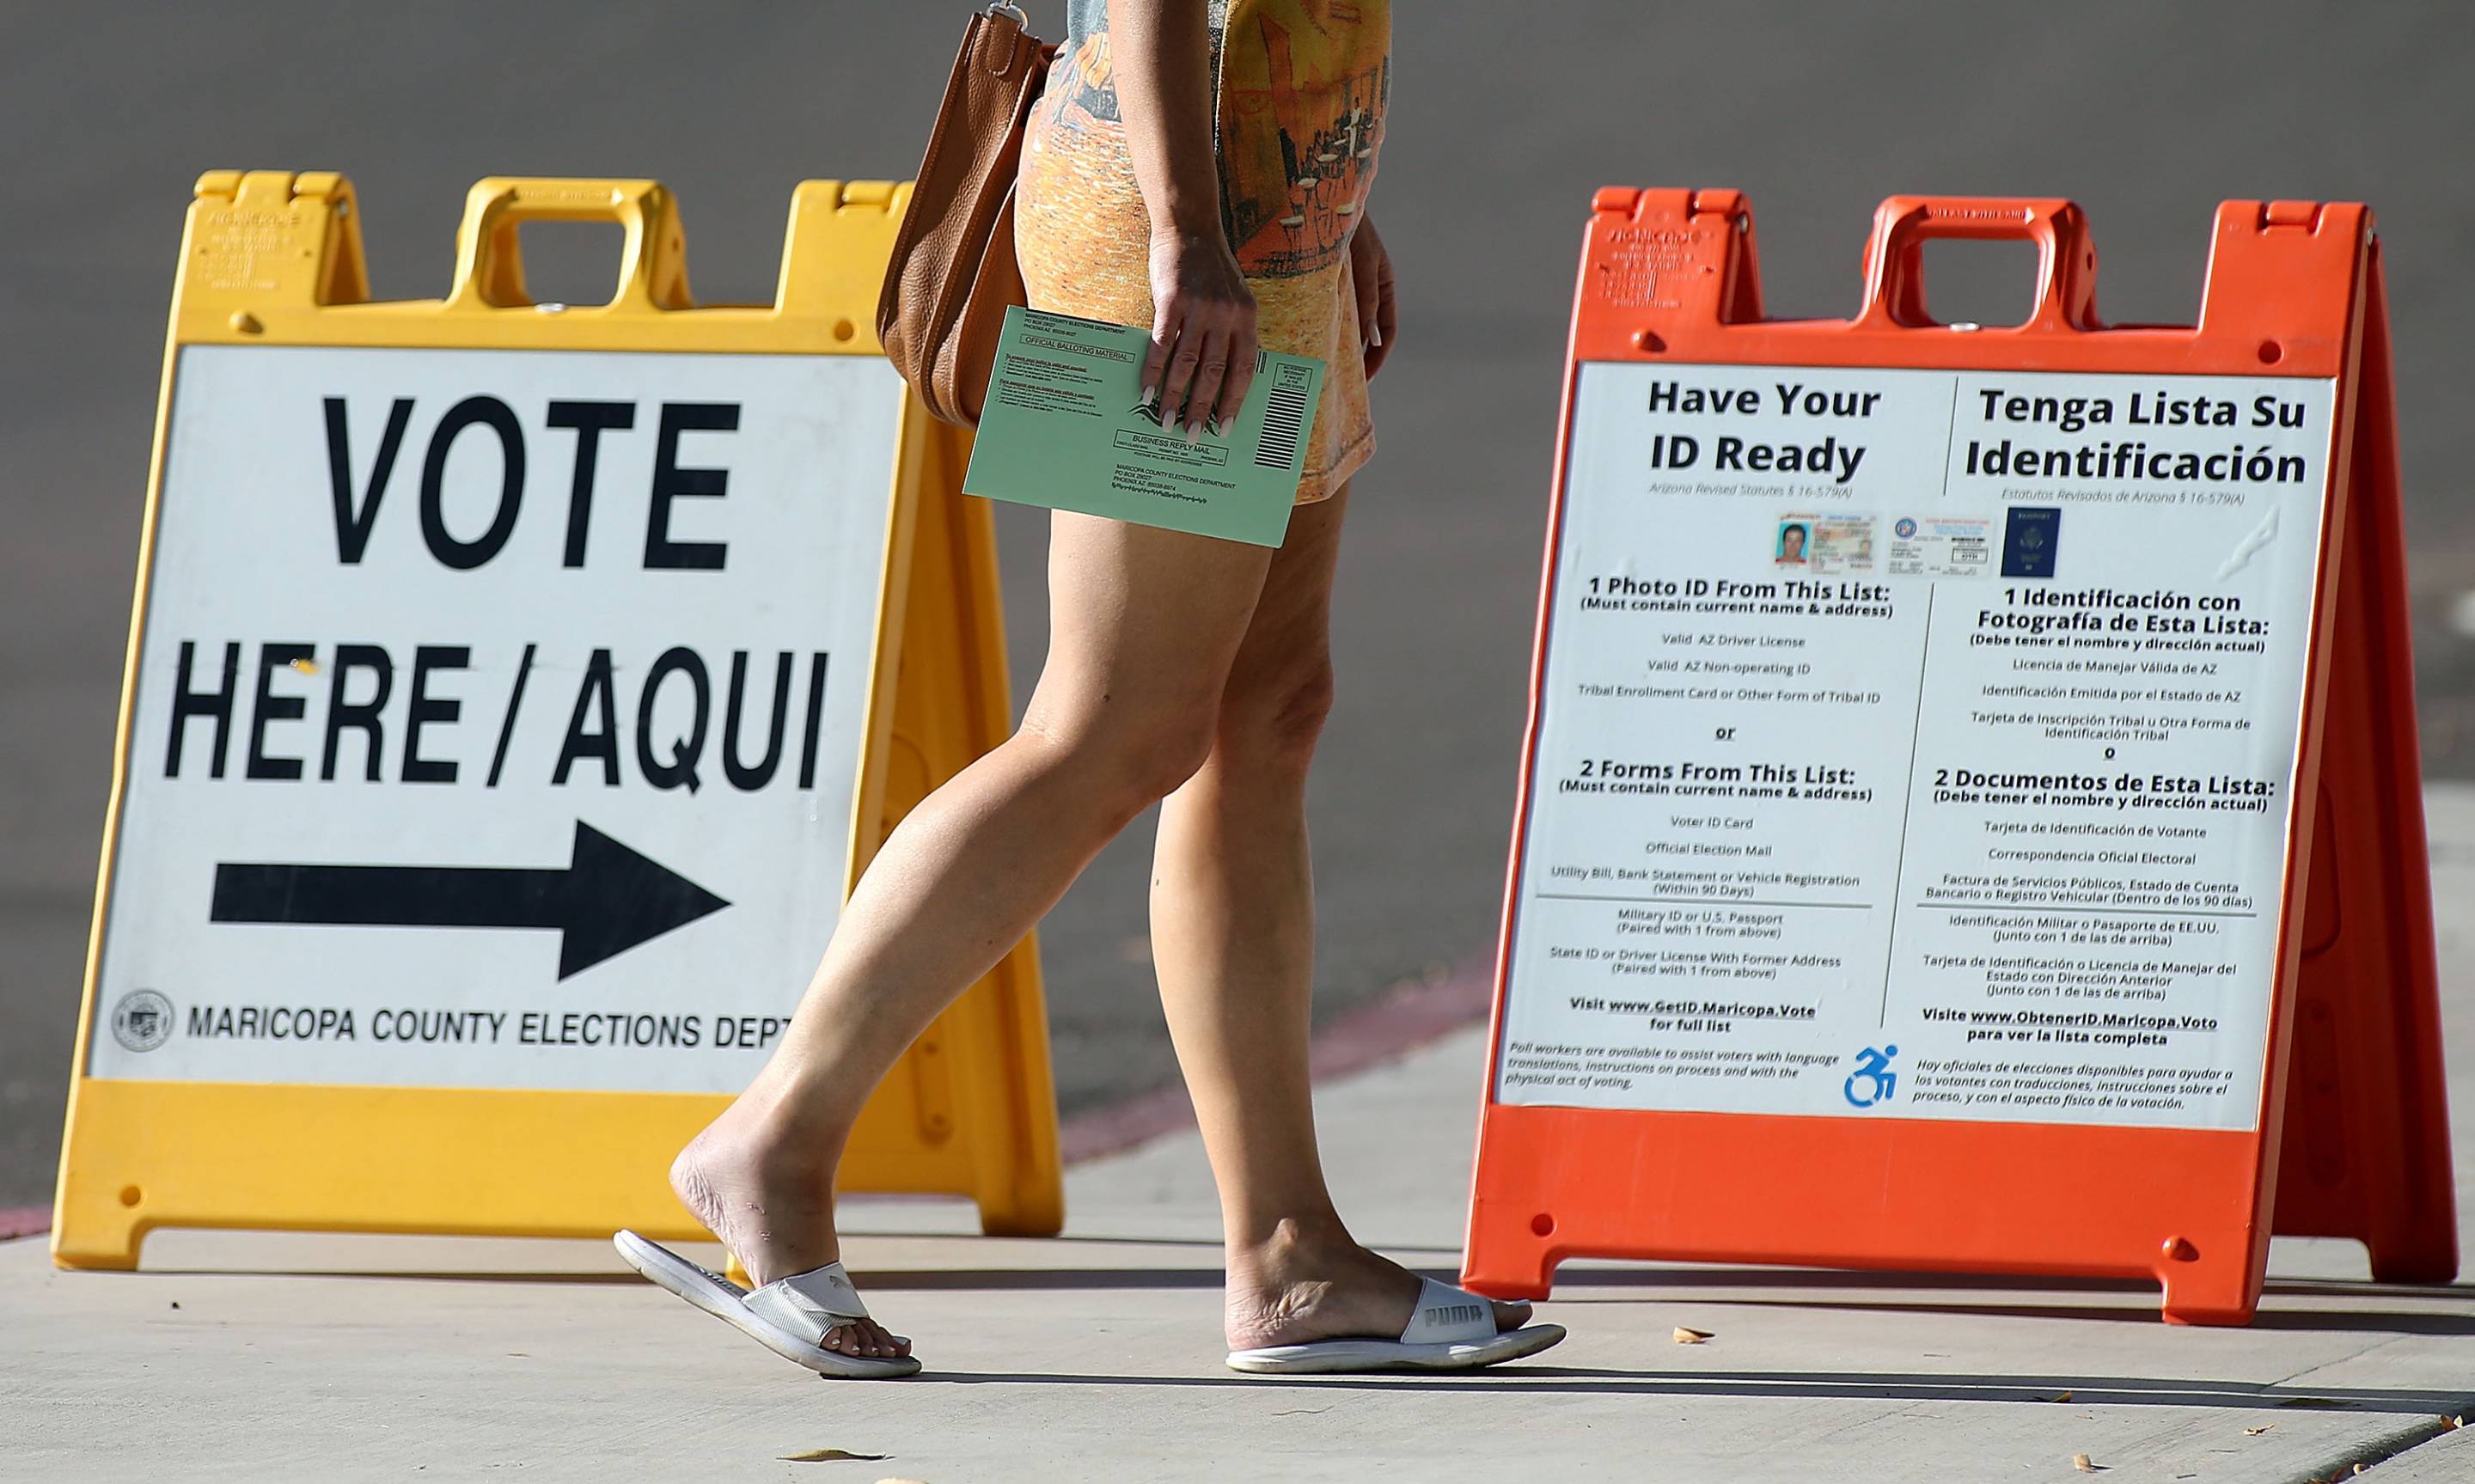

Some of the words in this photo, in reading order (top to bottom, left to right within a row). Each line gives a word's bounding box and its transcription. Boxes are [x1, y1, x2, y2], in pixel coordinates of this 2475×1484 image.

[1025, 337, 1056, 348] OFFICIAL
[1057, 342, 1094, 354] BALLOTING
[1095, 349, 1128, 360] MATERIAL
[1648, 381, 1761, 415] Have
[1775, 383, 1882, 418] Your
[1979, 388, 2114, 434] Tenga
[2128, 390, 2238, 427] Lista
[2251, 394, 2306, 429] Su
[1133, 435, 1169, 447] BUSINESS
[1170, 441, 1194, 451] REPLY
[1194, 445, 1210, 455] MAIL
[1651, 434, 1700, 470] ID
[1714, 436, 1867, 484] Ready
[1965, 439, 2307, 484] Identificación
[321, 394, 742, 571] VOTE
[1116, 464, 1145, 474] MARICOPA
[1145, 468, 1168, 478] COUNTY
[1169, 473, 1200, 483] ELECTIONS
[1200, 478, 1236, 489] DEPARTMENT
[1589, 577, 1600, 595] 1
[1607, 576, 1678, 597] Photo
[1684, 578, 1709, 597] ID
[1715, 579, 1777, 600] From
[1784, 580, 1832, 601] This
[1839, 581, 1891, 602] List:
[2004, 588, 2016, 606] 1
[2023, 587, 2191, 611] Identificación
[2197, 596, 2241, 612] con
[1580, 596, 1626, 610] (Must
[1630, 599, 1691, 613] contain
[1695, 602, 1755, 614] current
[1758, 603, 1805, 615] name
[1807, 602, 1820, 615] &
[1824, 602, 1894, 620] address)
[1977, 610, 2103, 633] Fotografía
[2109, 612, 2139, 632] de
[2145, 614, 2197, 634] Esta
[2203, 614, 2270, 636] Lista:
[1662, 632, 1694, 645] Valid
[1698, 633, 1716, 646] AZ
[1717, 634, 1757, 647] Driver
[1758, 635, 1806, 649] License
[1970, 633, 2012, 646] (Debe
[2014, 635, 2055, 647] tener
[2056, 635, 2071, 648] el
[2073, 636, 2130, 650] nombre
[2132, 639, 2142, 653] y
[2144, 637, 2212, 651] dirección
[2214, 640, 2265, 655] actual)
[1647, 659, 1679, 672] Valid
[1684, 660, 1702, 673] AZ
[1703, 660, 1795, 678] Non-operating
[1797, 663, 1812, 675] ID
[2013, 658, 2063, 671] Licencia
[2065, 659, 2082, 672] de
[2085, 659, 2137, 676] Manejar
[2140, 661, 2179, 675] Válida
[2181, 663, 2198, 675] de
[2200, 663, 2218, 675] AZ
[1578, 684, 1615, 696] Tribal
[1616, 685, 1685, 699] Enrollment
[1688, 687, 1719, 699] Card
[1720, 690, 1733, 700] or
[1737, 687, 1775, 701] Other
[1776, 689, 1810, 702] Form
[1812, 690, 1827, 703] of
[1829, 691, 1865, 704] Tribal
[1867, 692, 1881, 705] ID
[1715, 727, 1737, 741] or
[2104, 747, 2116, 760] o
[1580, 759, 1593, 778] 2
[1600, 760, 1674, 780] Forms
[1680, 762, 1742, 782] From
[1749, 763, 1798, 784] This
[1804, 765, 1855, 785] List:
[1934, 768, 1949, 787] 2
[1955, 769, 2108, 792] Documentos
[2113, 773, 2144, 793] de
[2150, 774, 2202, 795] Esta
[2208, 775, 2276, 797] Lista:
[1559, 779, 1605, 793] (Must
[1610, 781, 1671, 796] contain
[1674, 785, 1735, 797] current
[1738, 786, 1784, 798] name
[1787, 785, 1800, 798] &
[1803, 786, 1873, 803] address)
[1933, 789, 1981, 803] (Debe
[1984, 791, 2030, 805] tener
[2032, 791, 2048, 806] el
[2050, 792, 2115, 808] nombre
[2117, 796, 2129, 811] y
[2131, 793, 2207, 810] dirección
[2209, 797, 2268, 815] actual)
[1671, 815, 1704, 828] Voter
[1707, 815, 1722, 829] ID
[1723, 816, 1754, 830] Card
[1985, 821, 2028, 836] Tarjeta
[2030, 821, 2047, 834] de
[2050, 821, 2136, 837] Identificación
[2137, 824, 2154, 838] de
[2156, 825, 2207, 839] Votante
[1645, 842, 1691, 855] Official
[1692, 843, 1743, 857] Election
[1745, 845, 1773, 857] Mail
[1988, 848, 2095, 864] Correspondencia
[2098, 851, 2139, 864] Oficial
[2141, 852, 2197, 865] Electoral
[1570, 997, 1604, 1011] Visit
[1609, 1000, 1816, 1019] www.GetID.Maricopa.Vote
[1922, 1007, 1967, 1022] Visite
[1971, 1010, 2218, 1031] www.ObtenerID.Maricopa.Voto
[187, 1005, 356, 1040] MARICOPA
[372, 1009, 507, 1042] COUNTY
[519, 1012, 701, 1047] ELECTIONS
[1650, 1017, 1673, 1031] for
[1677, 1018, 1703, 1032] full
[1706, 1018, 1731, 1033] list
[1966, 1029, 2003, 1043] para
[2007, 1030, 2034, 1042] ver
[2036, 1028, 2051, 1042] la
[2055, 1029, 2090, 1043] lista
[2093, 1031, 2168, 1048] completa
[1504, 1072, 1556, 1087] physical
[1556, 1075, 1577, 1087] act
[1578, 1074, 1594, 1090] of
[1593, 1076, 1633, 1091] voting.
[1425, 1304, 1483, 1328] PUMA
